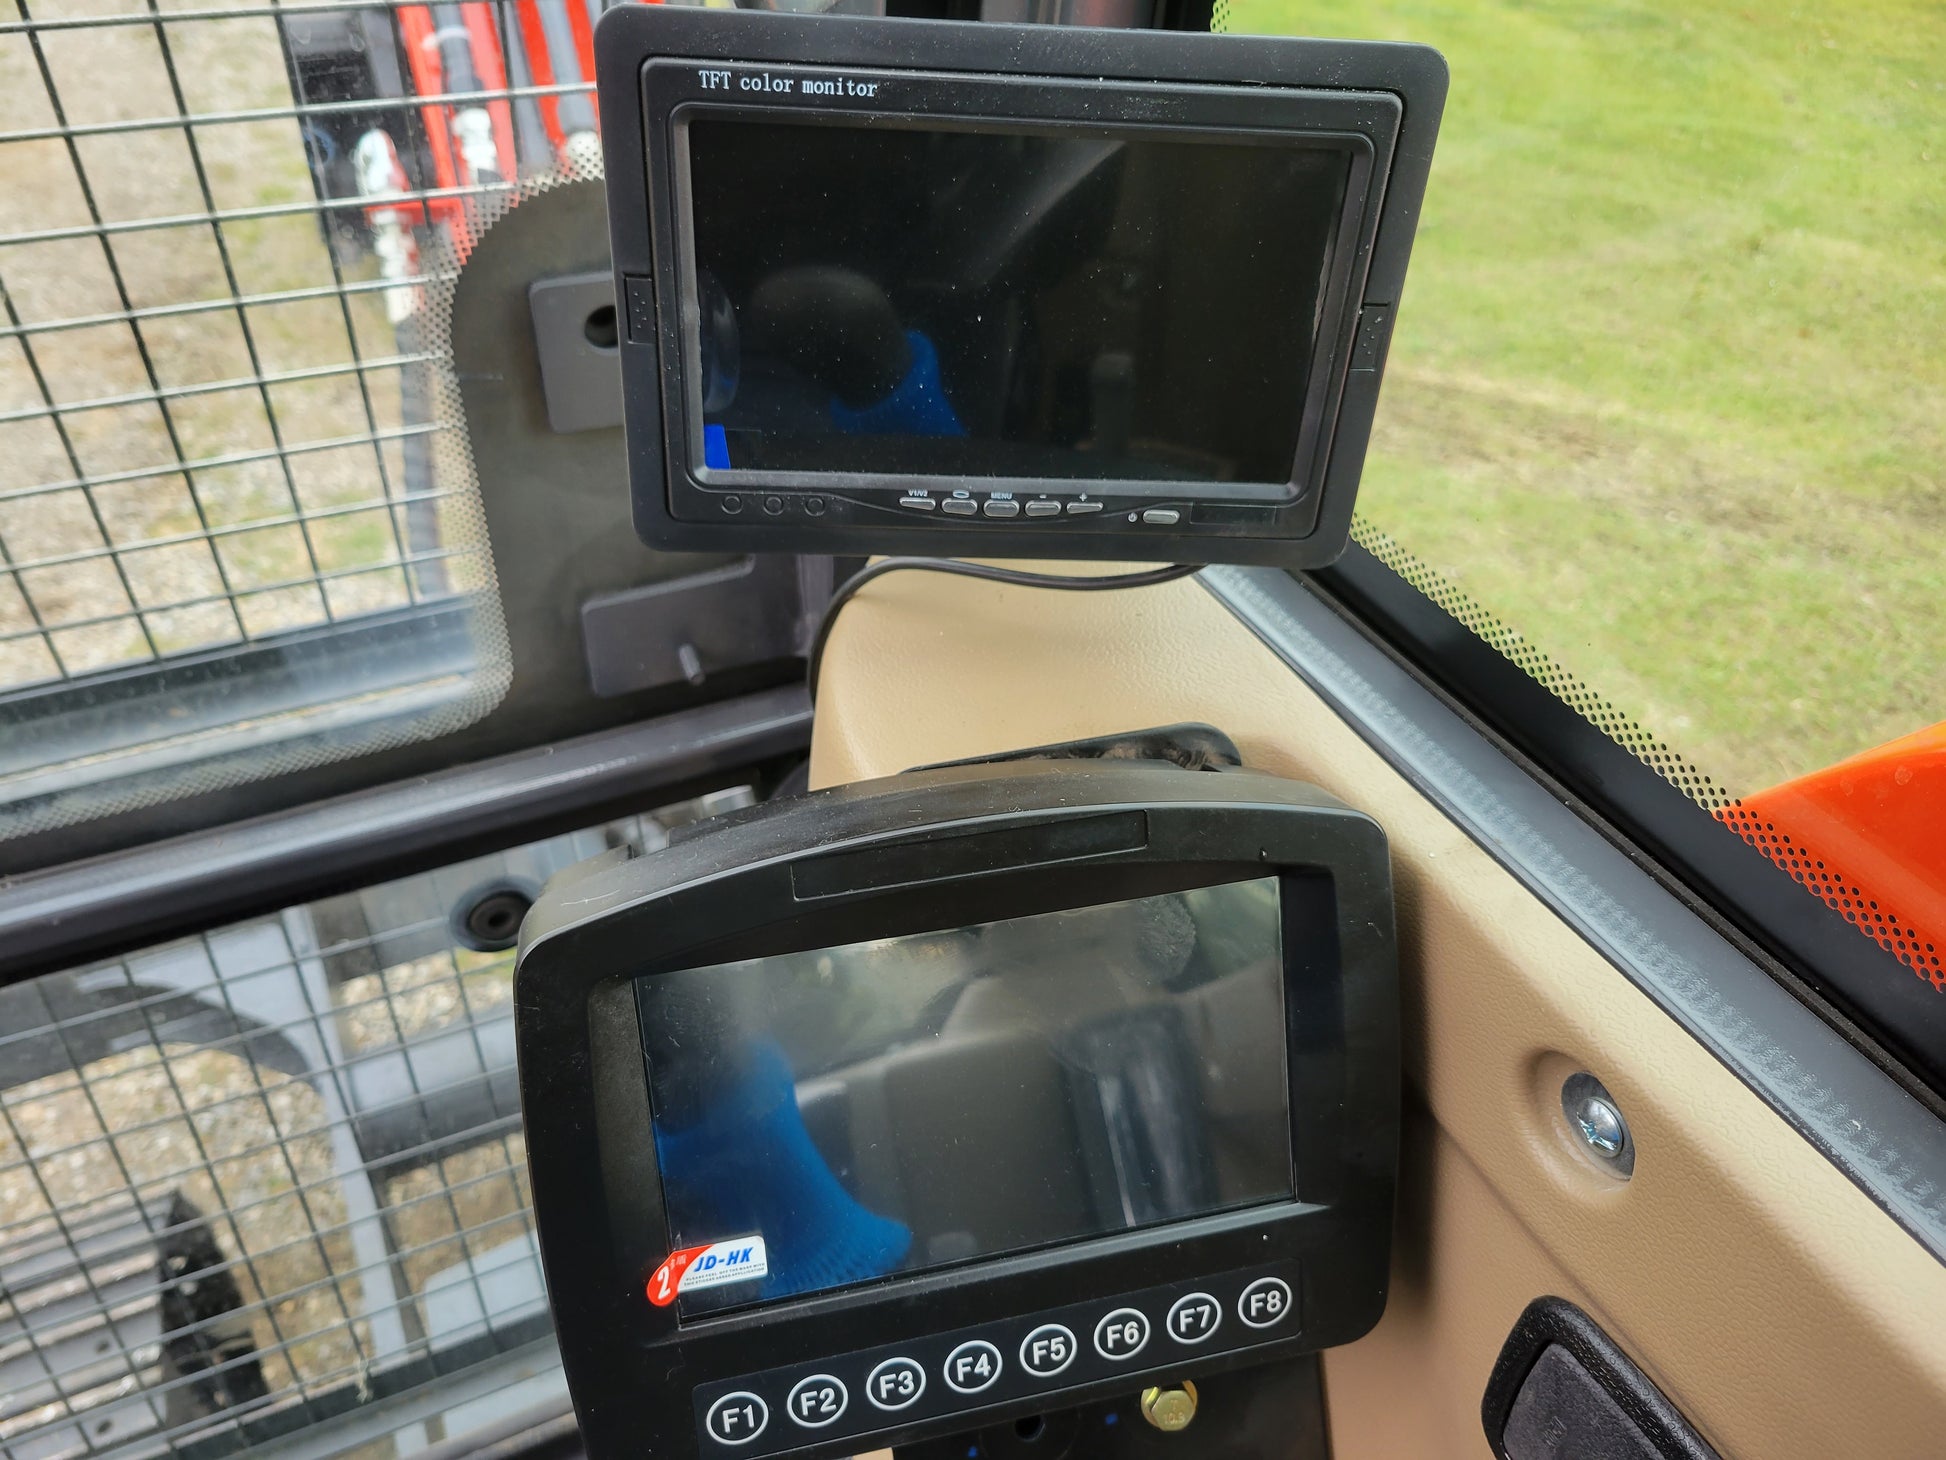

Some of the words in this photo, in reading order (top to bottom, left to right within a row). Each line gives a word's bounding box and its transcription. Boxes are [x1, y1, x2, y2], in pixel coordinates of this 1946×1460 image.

[698, 70, 732, 90] TFT
[740, 73, 795, 92] color
[802, 77, 878, 97] monitor
[990, 491, 1013, 500] MENU
[693, 1246, 754, 1272] JD-HK
[657, 1265, 671, 1300] 2
[722, 1404, 755, 1433] F1
[800, 1387, 836, 1416] F2
[880, 1370, 914, 1399] F3
[956, 1353, 991, 1382] F4
[1033, 1336, 1066, 1365] F5
[1106, 1320, 1140, 1349] F6
[1179, 1305, 1211, 1333] F7
[1250, 1290, 1282, 1317] F8
